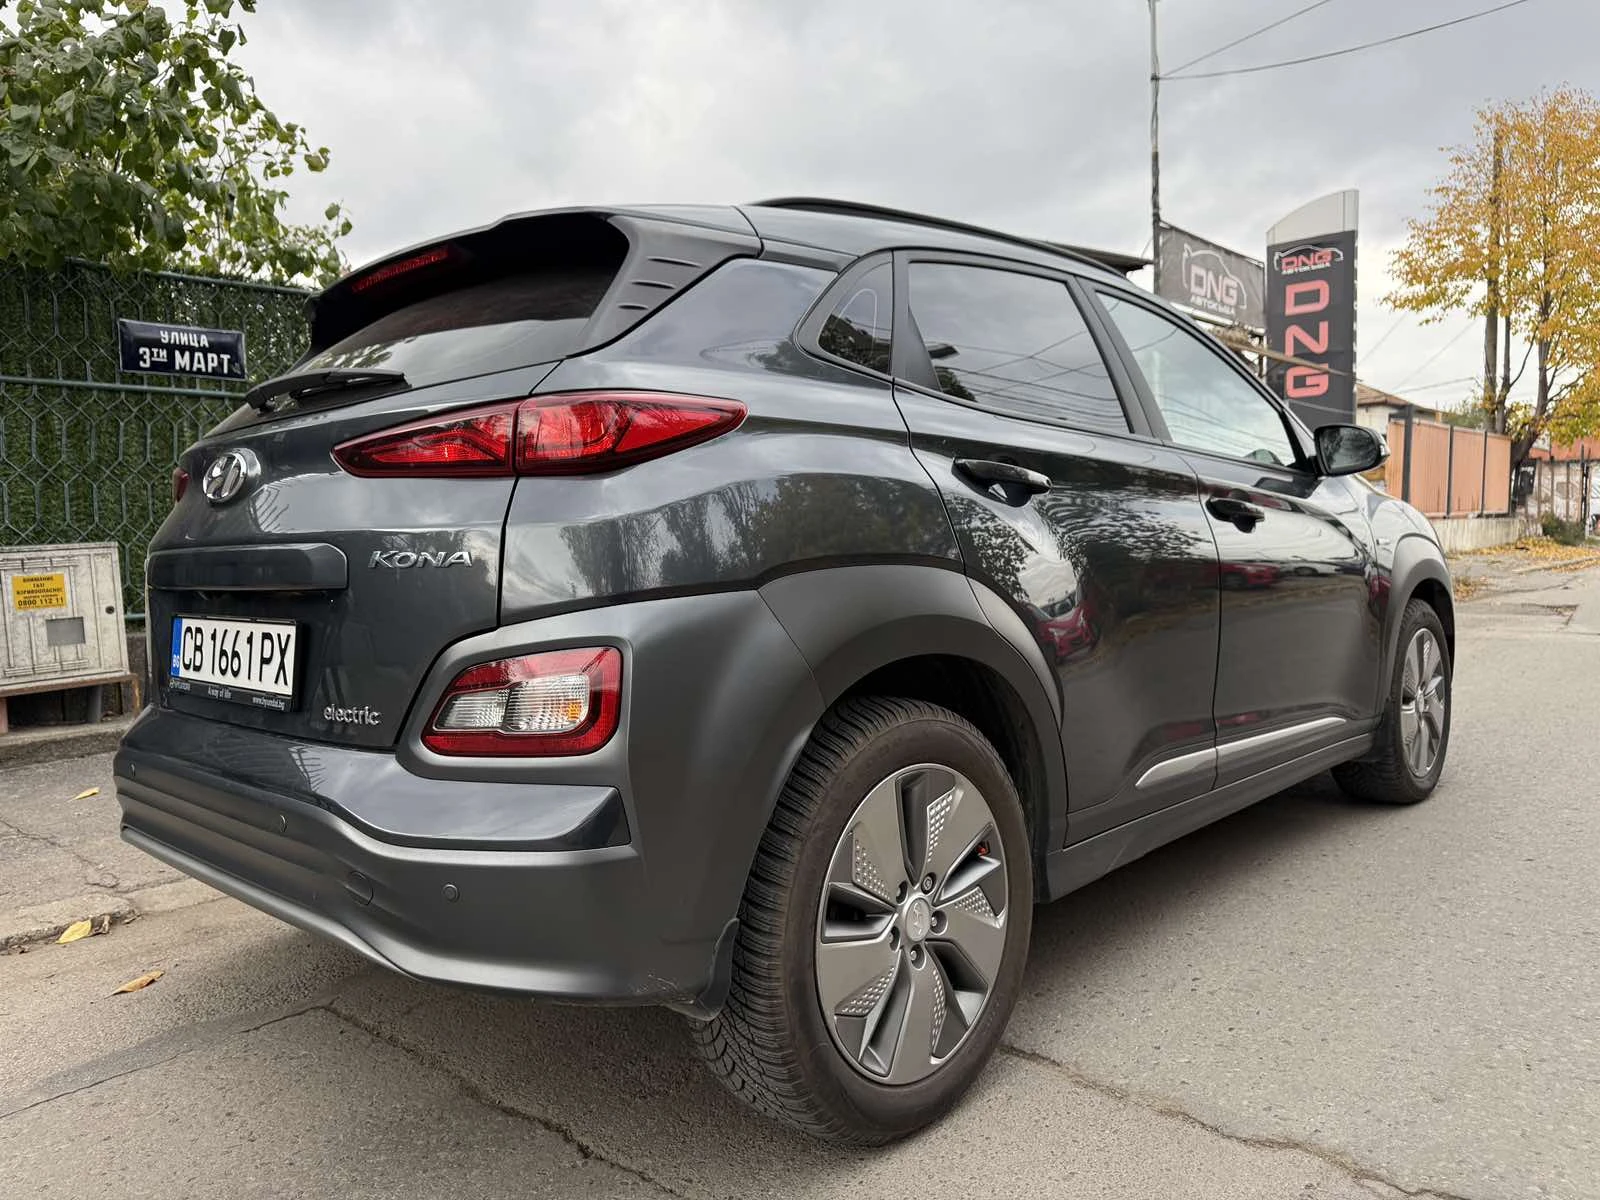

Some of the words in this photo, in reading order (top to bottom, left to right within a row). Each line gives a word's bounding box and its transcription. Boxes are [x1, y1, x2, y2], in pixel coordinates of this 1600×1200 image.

[1281, 250, 1331, 271] DNG
[1190, 265, 1237, 305] DNG
[160, 330, 209, 348] УЛИЦА
[1285, 280, 1329, 398] DNG
[174, 349, 231, 374] МАРТ
[368, 550, 473, 569] KONA
[210, 628, 254, 681] 1661
[258, 632, 291, 686] PX
[323, 704, 381, 726] electric
